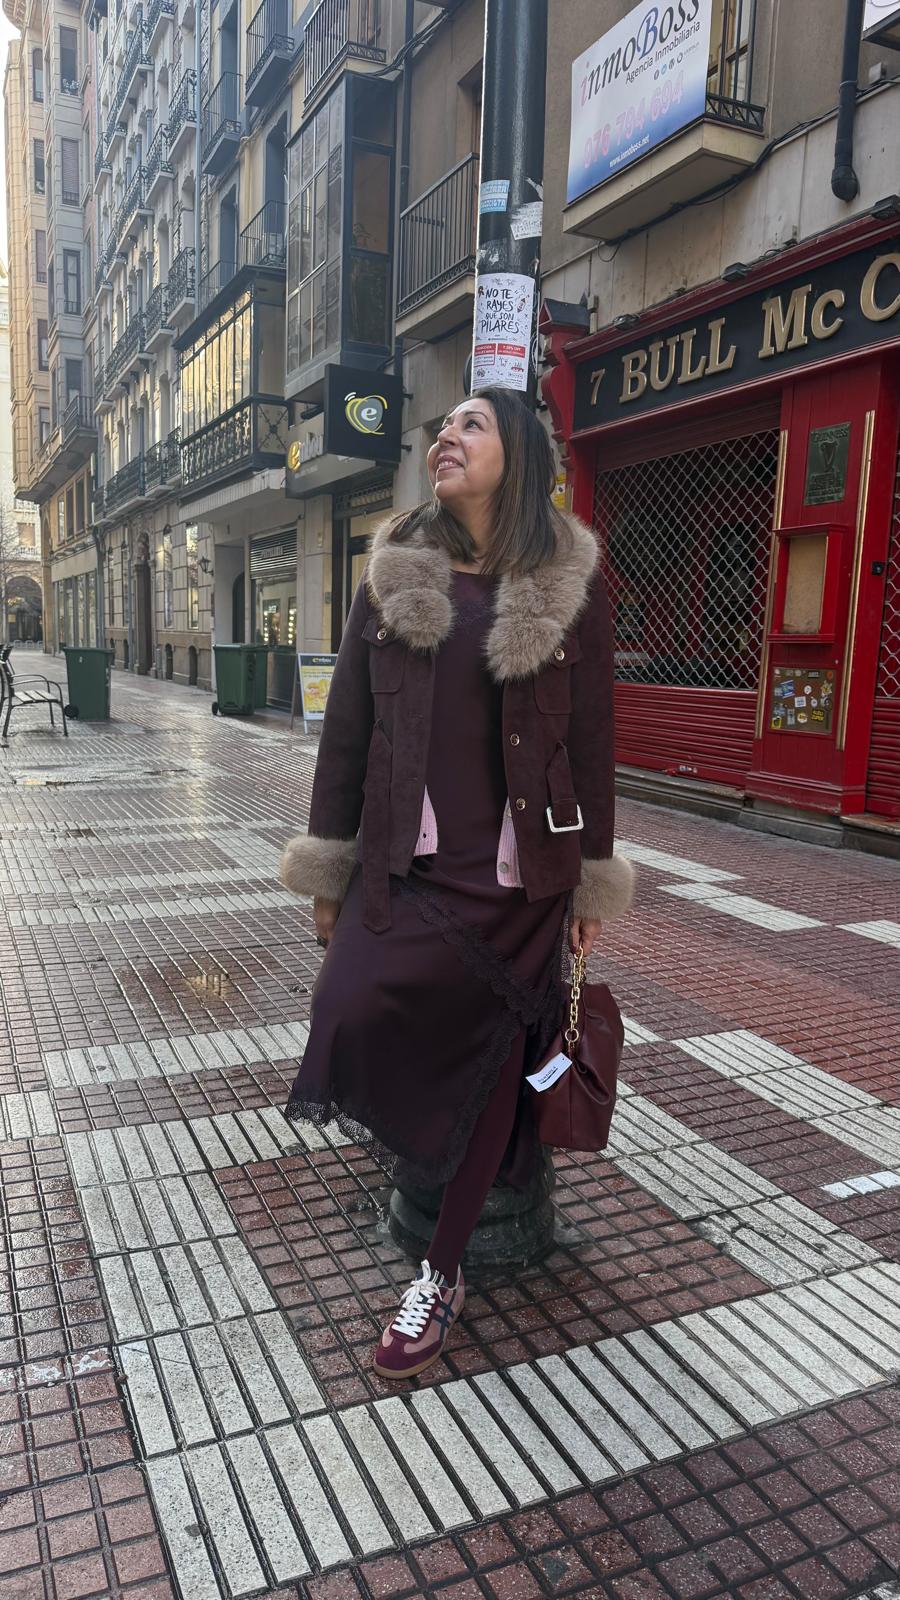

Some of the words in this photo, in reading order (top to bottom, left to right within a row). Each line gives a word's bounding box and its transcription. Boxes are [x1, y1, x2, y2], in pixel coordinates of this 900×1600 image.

[625, 56, 654, 85] Agencia
[655, 21, 700, 63] Inmobiliaria
[485, 287, 499, 299] NO
[500, 288, 514, 300] TE
[486, 299, 514, 312] RAYES
[485, 312, 498, 320] QUE
[499, 312, 515, 321] SON
[480, 319, 520, 334] PILARES
[590, 368, 606, 406] 7
[619, 317, 737, 404] BULL
